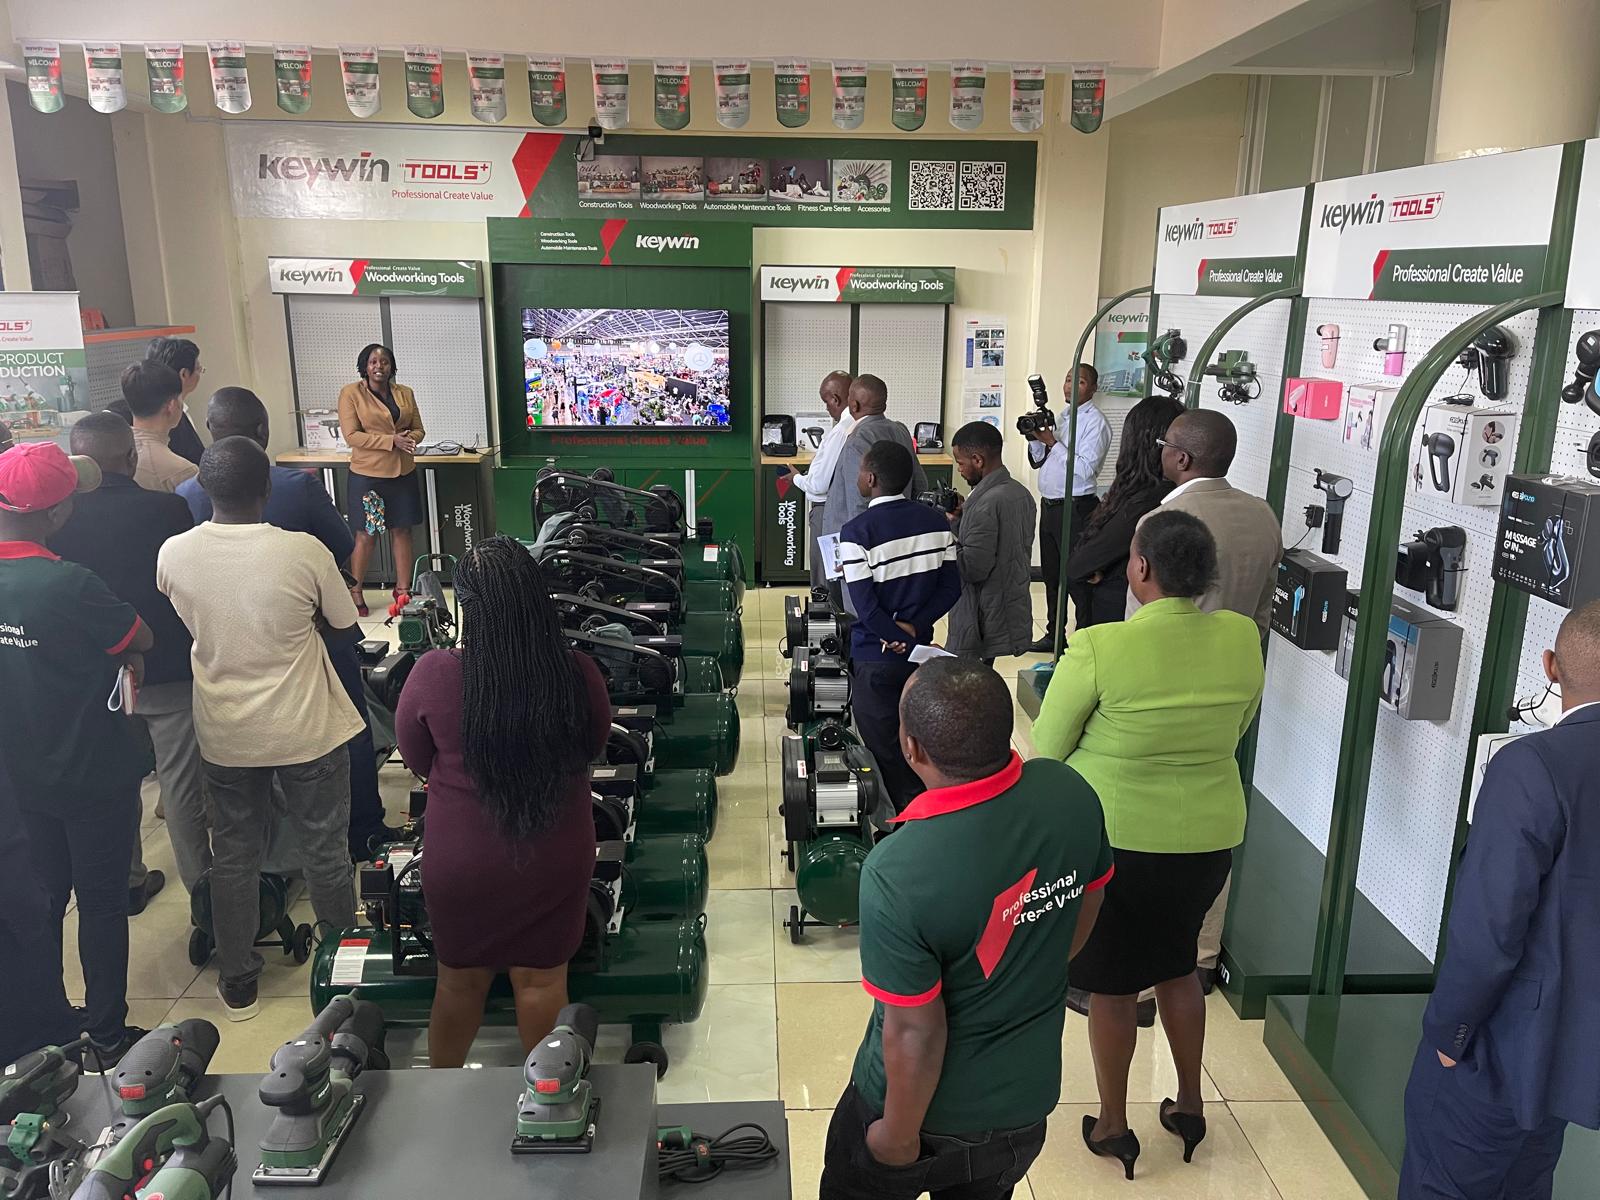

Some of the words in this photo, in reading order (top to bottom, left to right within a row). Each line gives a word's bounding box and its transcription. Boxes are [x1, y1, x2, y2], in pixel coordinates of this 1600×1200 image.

[408, 64, 440, 73] WELCOME
[657, 77, 688, 85] WELCOME
[258, 152, 390, 190] keywin
[392, 190, 442, 200] Professional
[443, 190, 469, 200] Create
[470, 191, 494, 201] Value
[579, 201, 617, 209] Construction
[618, 201, 633, 209] Tools
[640, 202, 681, 211] Woodworking
[703, 203, 738, 211] Automobile
[738, 203, 776, 211] Maintenance
[798, 204, 819, 212] Fitness
[857, 205, 891, 213] Accessories
[1320, 193, 1384, 235] keywin
[1164, 217, 1204, 248] keywin
[635, 234, 700, 252] keywin
[279, 267, 343, 285] keywin
[365, 271, 438, 285] Woodworking
[438, 272, 465, 283] Tools
[1208, 268, 1243, 283] Professional
[1243, 269, 1264, 283] Create
[1264, 269, 1283, 283] Value
[1392, 263, 1451, 282] Professional
[1452, 264, 1489, 283] Create
[1490, 262, 1523, 283] Value
[769, 275, 830, 293] keywin
[850, 279, 918, 292] Woodworking
[919, 280, 944, 290] Tools
[1108, 312, 1149, 325] keywin
[0, 352, 64, 365] PRODUCT
[454, 503, 464, 528] Tools
[778, 500, 788, 525] Tools
[784, 500, 797, 566] Woodworking
[1002, 869, 1077, 922] Professional
